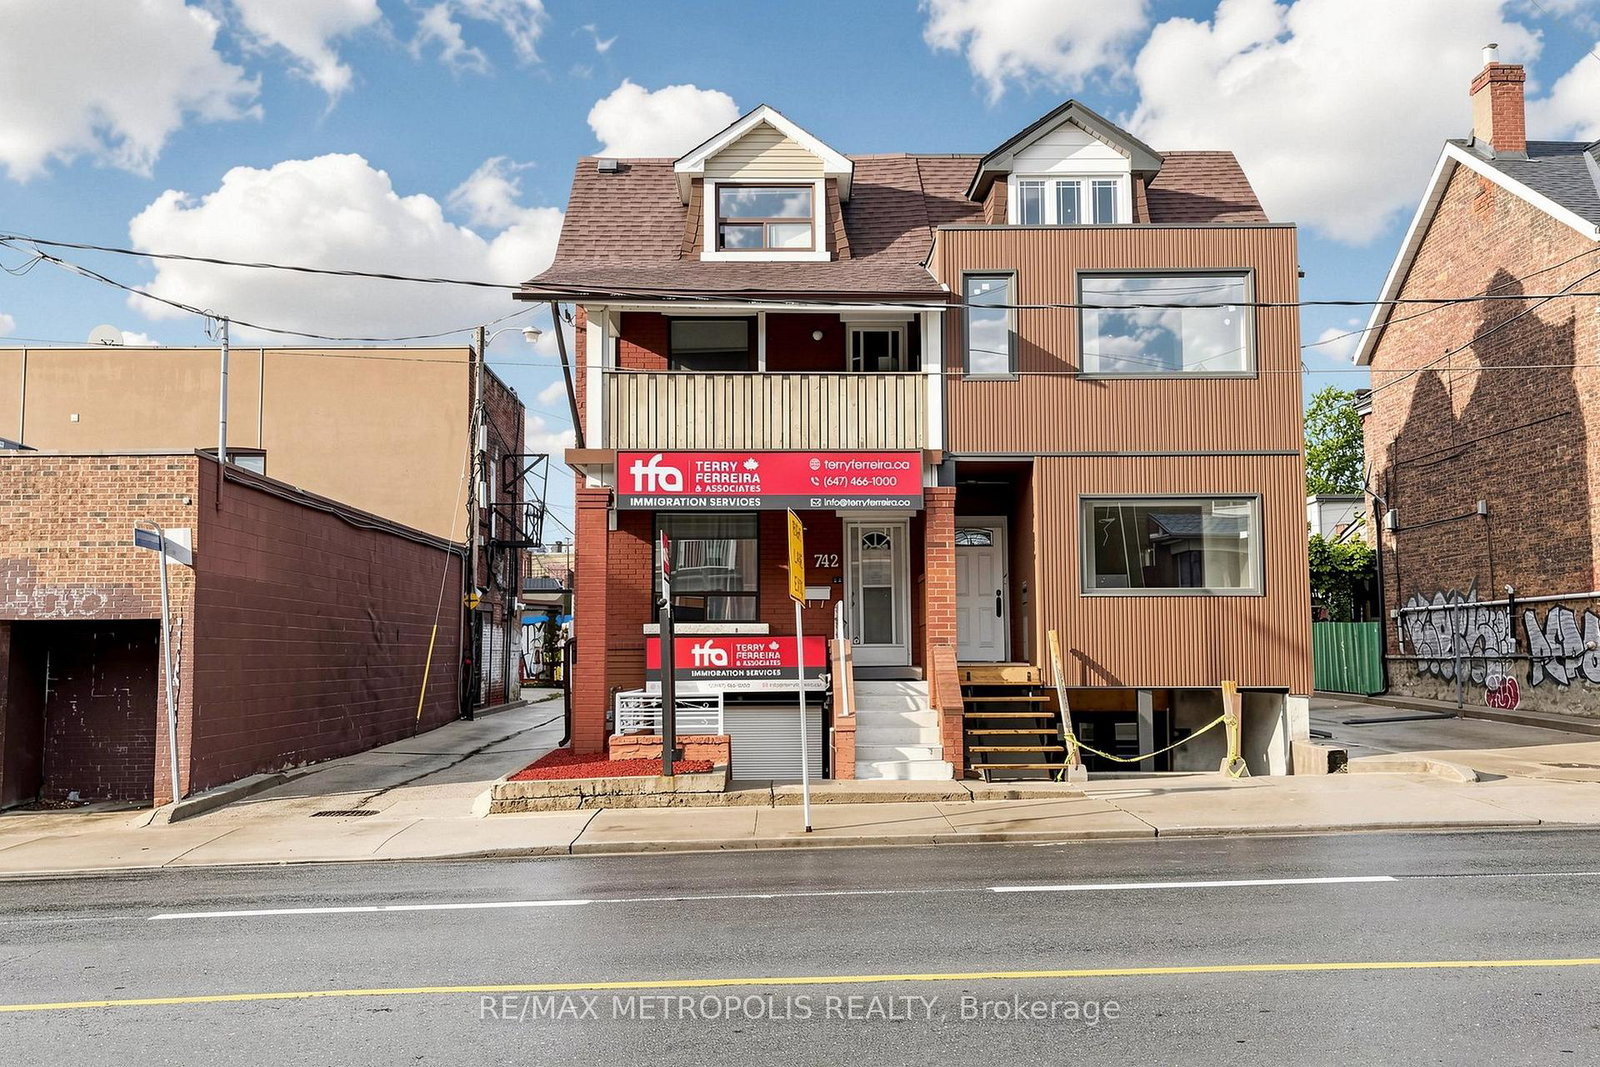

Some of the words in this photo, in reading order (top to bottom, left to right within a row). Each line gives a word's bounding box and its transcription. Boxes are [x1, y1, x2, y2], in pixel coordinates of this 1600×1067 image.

[695, 461, 738, 472] TERRY
[824, 459, 910, 472] terryferreira.ca
[630, 453, 683, 492] tfa
[695, 473, 761, 483] FERREIRA
[824, 476, 848, 488] (647)
[850, 476, 898, 487] 466-1000
[705, 485, 761, 493] ASSOCIATES
[630, 497, 707, 507] IMMIGRATION
[709, 497, 761, 507] SERVICES
[824, 498, 911, 508] info@terryferreira.ca
[813, 553, 840, 568] 742
[736, 643, 765, 651] TERRY
[691, 639, 728, 667] tfa
[691, 669, 745, 677] IMMIGRATION
[746, 669, 781, 677] SERVICES
